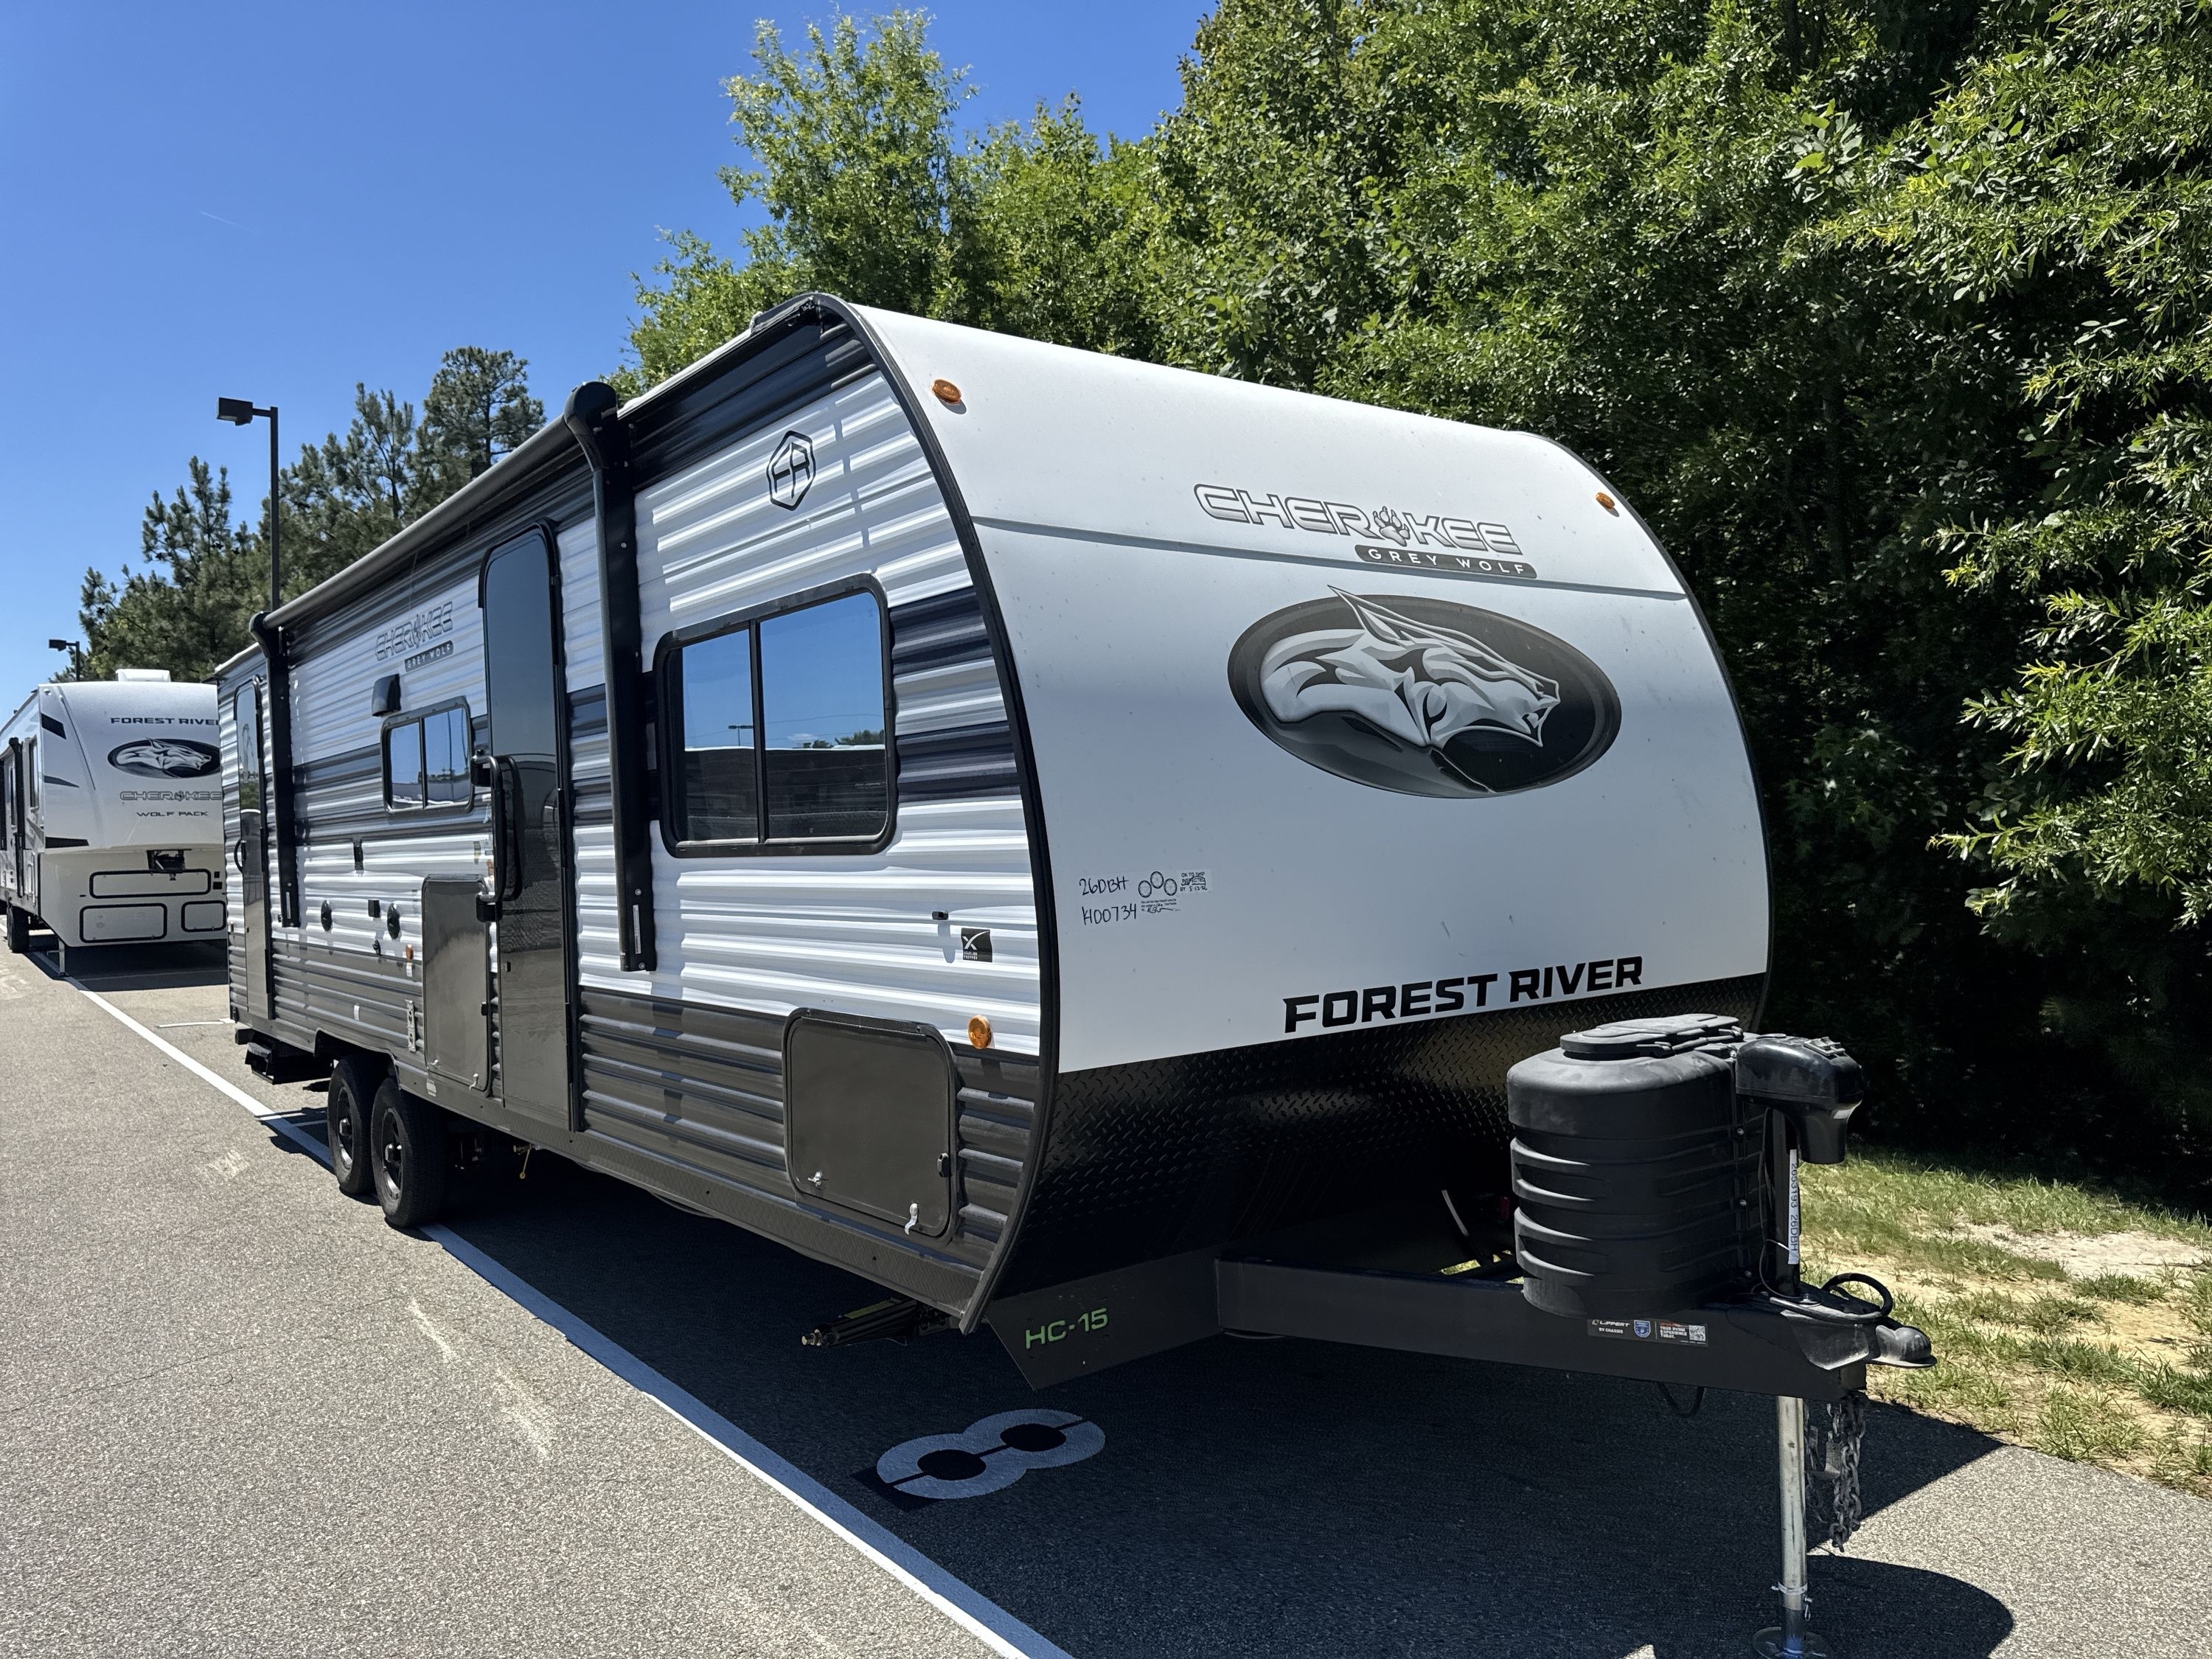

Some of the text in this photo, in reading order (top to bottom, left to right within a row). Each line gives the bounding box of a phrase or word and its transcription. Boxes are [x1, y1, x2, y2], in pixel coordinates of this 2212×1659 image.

[1368, 548, 1525, 575] GREY WOLF
[407, 644, 451, 669] GREY WOLF
[1079, 876, 1130, 895] 26DBH
[1282, 956, 1643, 1034] FOREST RIVER
[1790, 1214, 1798, 1251] 26DBH
[1026, 1307, 1108, 1350] HC-15
[876, 1408, 1106, 1500] 8
